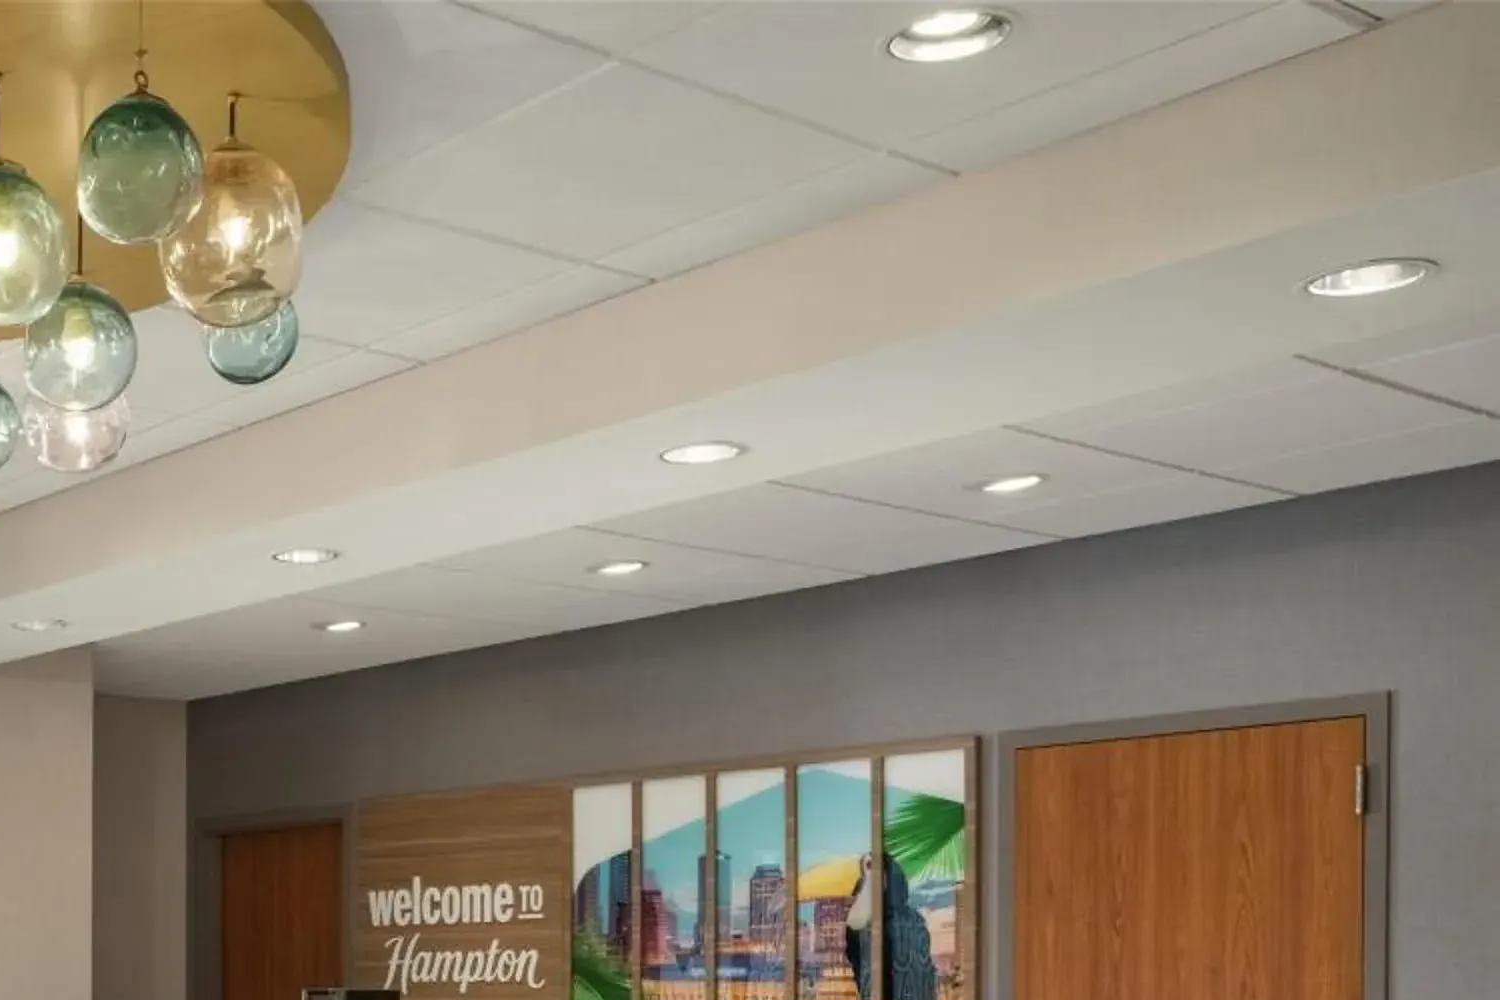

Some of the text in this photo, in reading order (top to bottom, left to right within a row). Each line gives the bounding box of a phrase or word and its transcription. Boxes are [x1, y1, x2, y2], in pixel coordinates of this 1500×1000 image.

[368, 876, 544, 927] welcome TO
[383, 932, 546, 995] Hampton
